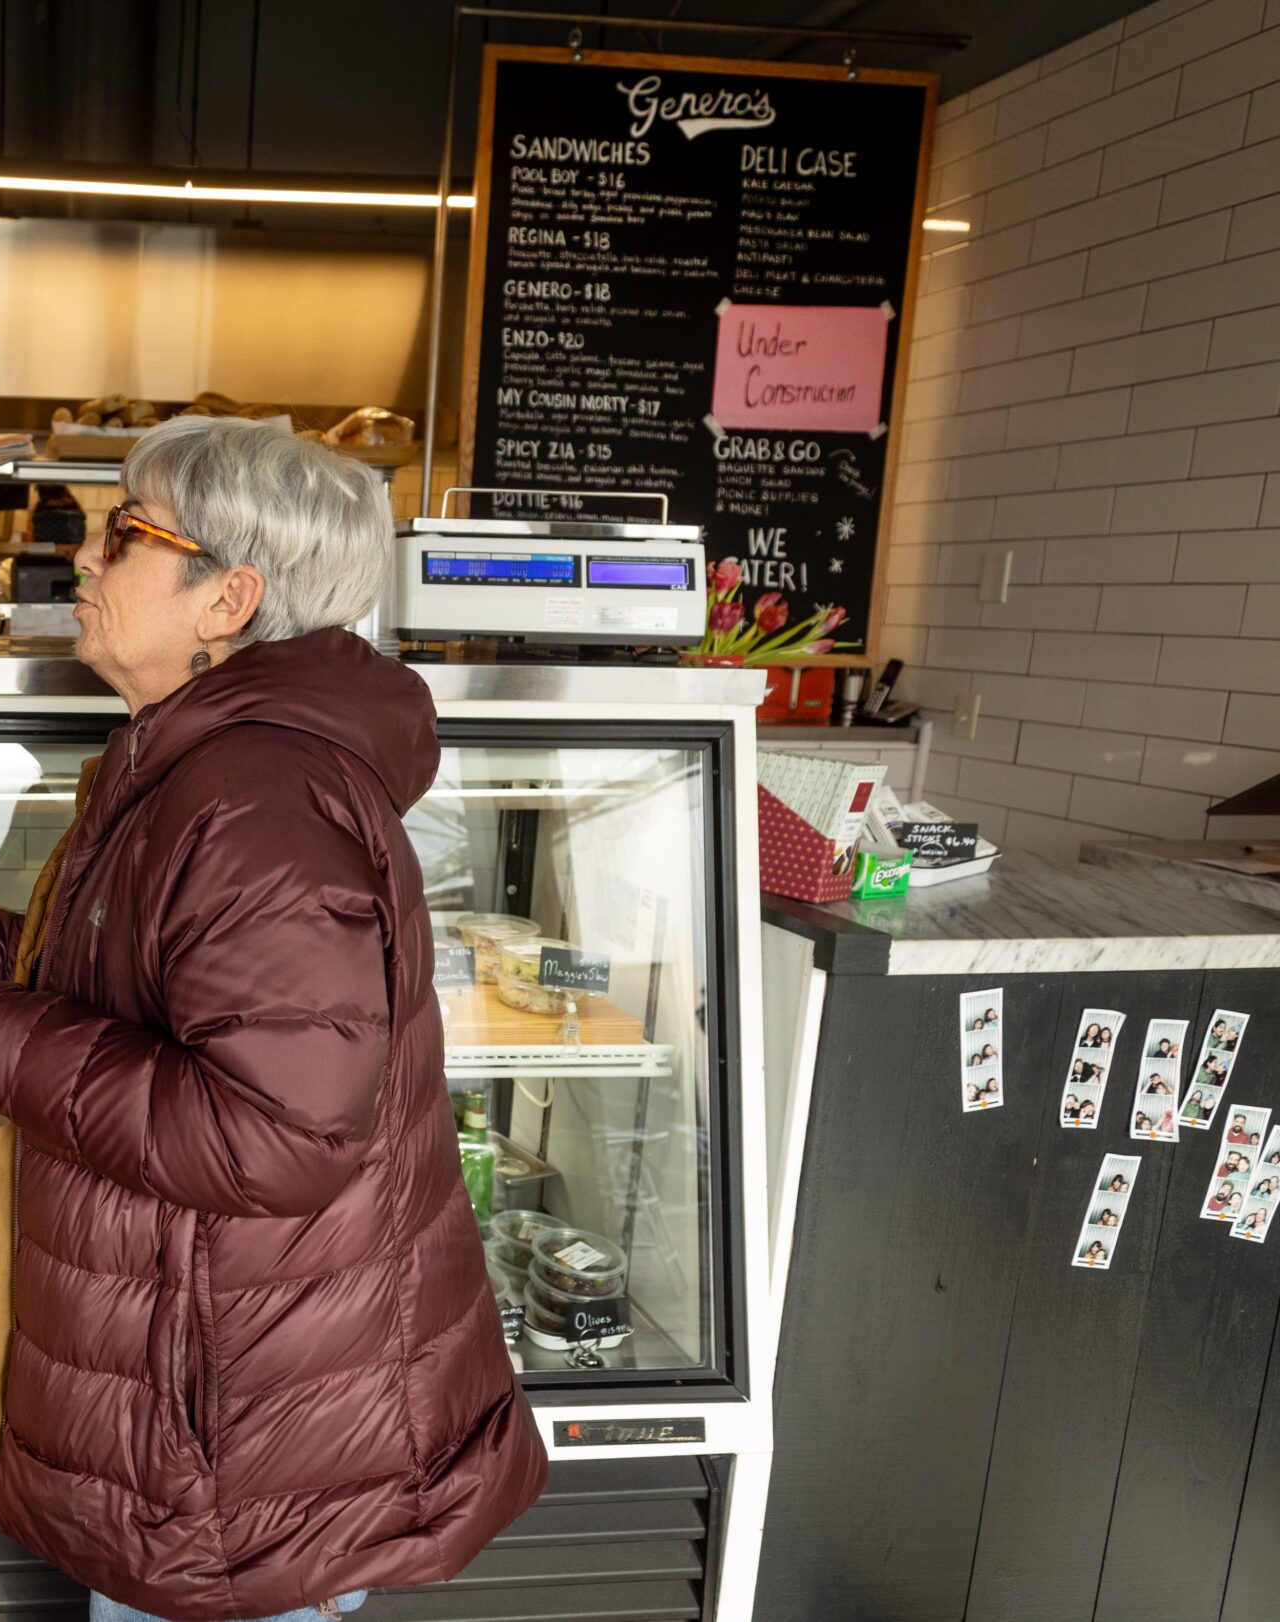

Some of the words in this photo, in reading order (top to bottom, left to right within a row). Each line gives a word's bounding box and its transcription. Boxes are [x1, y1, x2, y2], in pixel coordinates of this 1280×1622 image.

[616, 75, 772, 138] Genero's
[510, 134, 651, 165] SANDWICHES
[740, 144, 787, 174] DELI
[796, 147, 858, 178] CASE
[511, 166, 547, 182] POOL
[550, 168, 579, 185] BOY
[598, 172, 626, 190] $16
[507, 226, 567, 246] REGINA
[583, 230, 611, 251] $18
[502, 279, 572, 300] GENERO
[501, 328, 549, 348] ENZO
[557, 331, 585, 350] $20
[737, 320, 807, 358] Under
[496, 386, 524, 406] MY
[527, 389, 577, 410] COUSIN
[580, 394, 630, 414] MORTY
[638, 398, 661, 418] $17
[495, 437, 540, 458] SPICY
[548, 442, 575, 460] ZIA
[587, 444, 613, 461] $15
[491, 491, 551, 510] DOTTIE
[747, 527, 787, 558] WE
[904, 834, 942, 844] STICKS
[910, 824, 955, 835] SNACK
[544, 959, 589, 983] Maggie's
[575, 1312, 612, 1330] Olives
